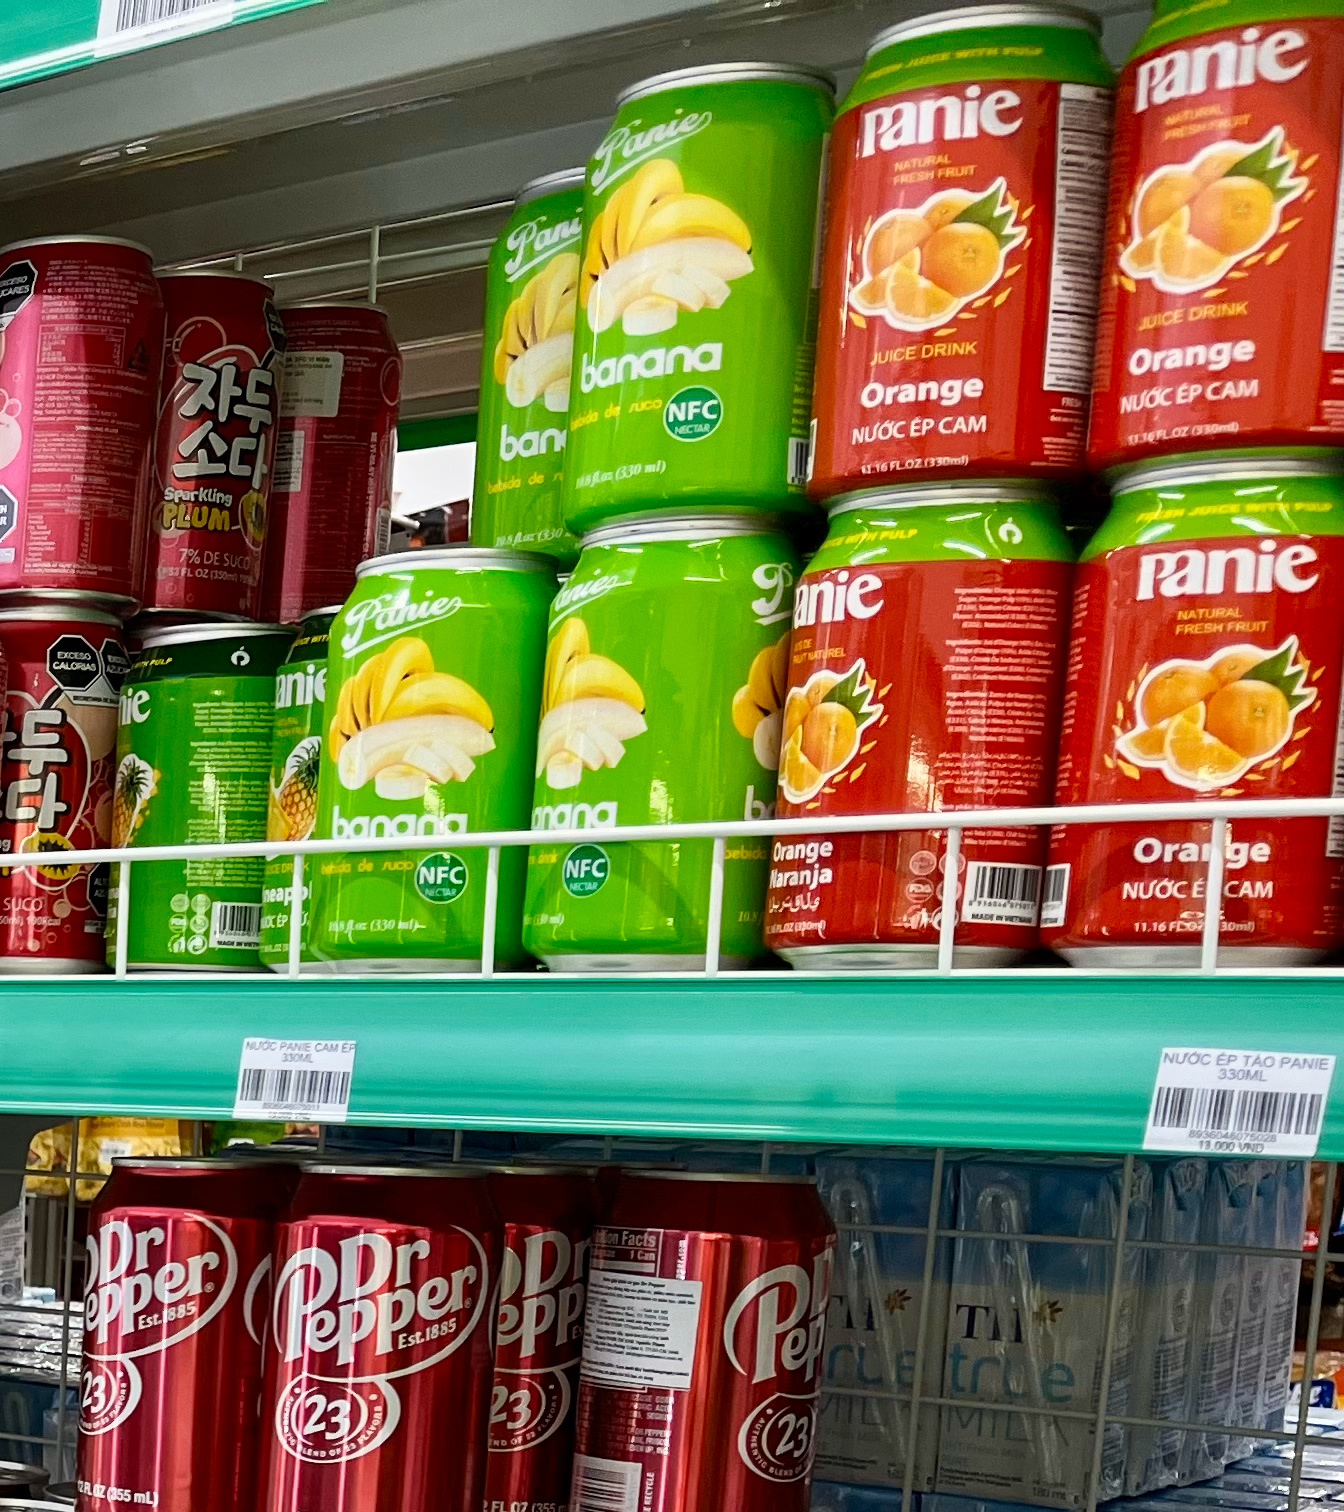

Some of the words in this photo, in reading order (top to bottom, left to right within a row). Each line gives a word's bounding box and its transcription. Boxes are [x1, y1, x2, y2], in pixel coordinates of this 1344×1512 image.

[1135, 28, 1310, 113] Panie
[862, 86, 1021, 159] Panie
[894, 155, 950, 171] NATURAL
[894, 169, 935, 186] FRESH
[938, 165, 976, 180] FRUIT
[1190, 301, 1248, 325] DRINK
[871, 346, 917, 366] JUICE
[922, 342, 977, 358] DRINK
[1129, 340, 1255, 375] Orange
[581, 342, 723, 393] banana
[861, 377, 984, 408] Orange
[1207, 380, 1258, 401] CAM
[668, 399, 718, 422] NFC
[675, 423, 710, 435] NECTAR
[852, 420, 906, 445] NƯỚC
[910, 415, 935, 438] ÉP
[939, 415, 987, 434] CAM
[164, 487, 233, 507] Sparkling
[163, 505, 231, 532] PLUM
[203, 550, 220, 565] DE
[224, 552, 251, 570] SUCO
[1136, 539, 1319, 601] Panie
[1178, 608, 1243, 620] NATURAL
[1176, 622, 1223, 635] FRESH
[1226, 620, 1269, 633] FRUIT
[772, 839, 833, 864] Orange
[418, 863, 465, 888] NFC
[566, 857, 605, 880] NFC
[1122, 879, 1188, 900] NƯỚC
[1223, 880, 1273, 899] CAM
[280, 1041, 311, 1052] PANIE
[314, 1042, 338, 1053] CAM
[283, 1053, 314, 1064] 330ML
[1163, 1052, 1211, 1067] NƯỚC
[1216, 1053, 1239, 1068] ÉP
[1280, 1057, 1329, 1072] PANIE
[1218, 1068, 1267, 1083] 330ML
[1238, 1142, 1264, 1154] VND
[338, 1233, 430, 1304] Dr
[274, 1247, 477, 1365] Pepper
[397, 1318, 457, 1350] Est.1885
[303, 1393, 351, 1441] 23
